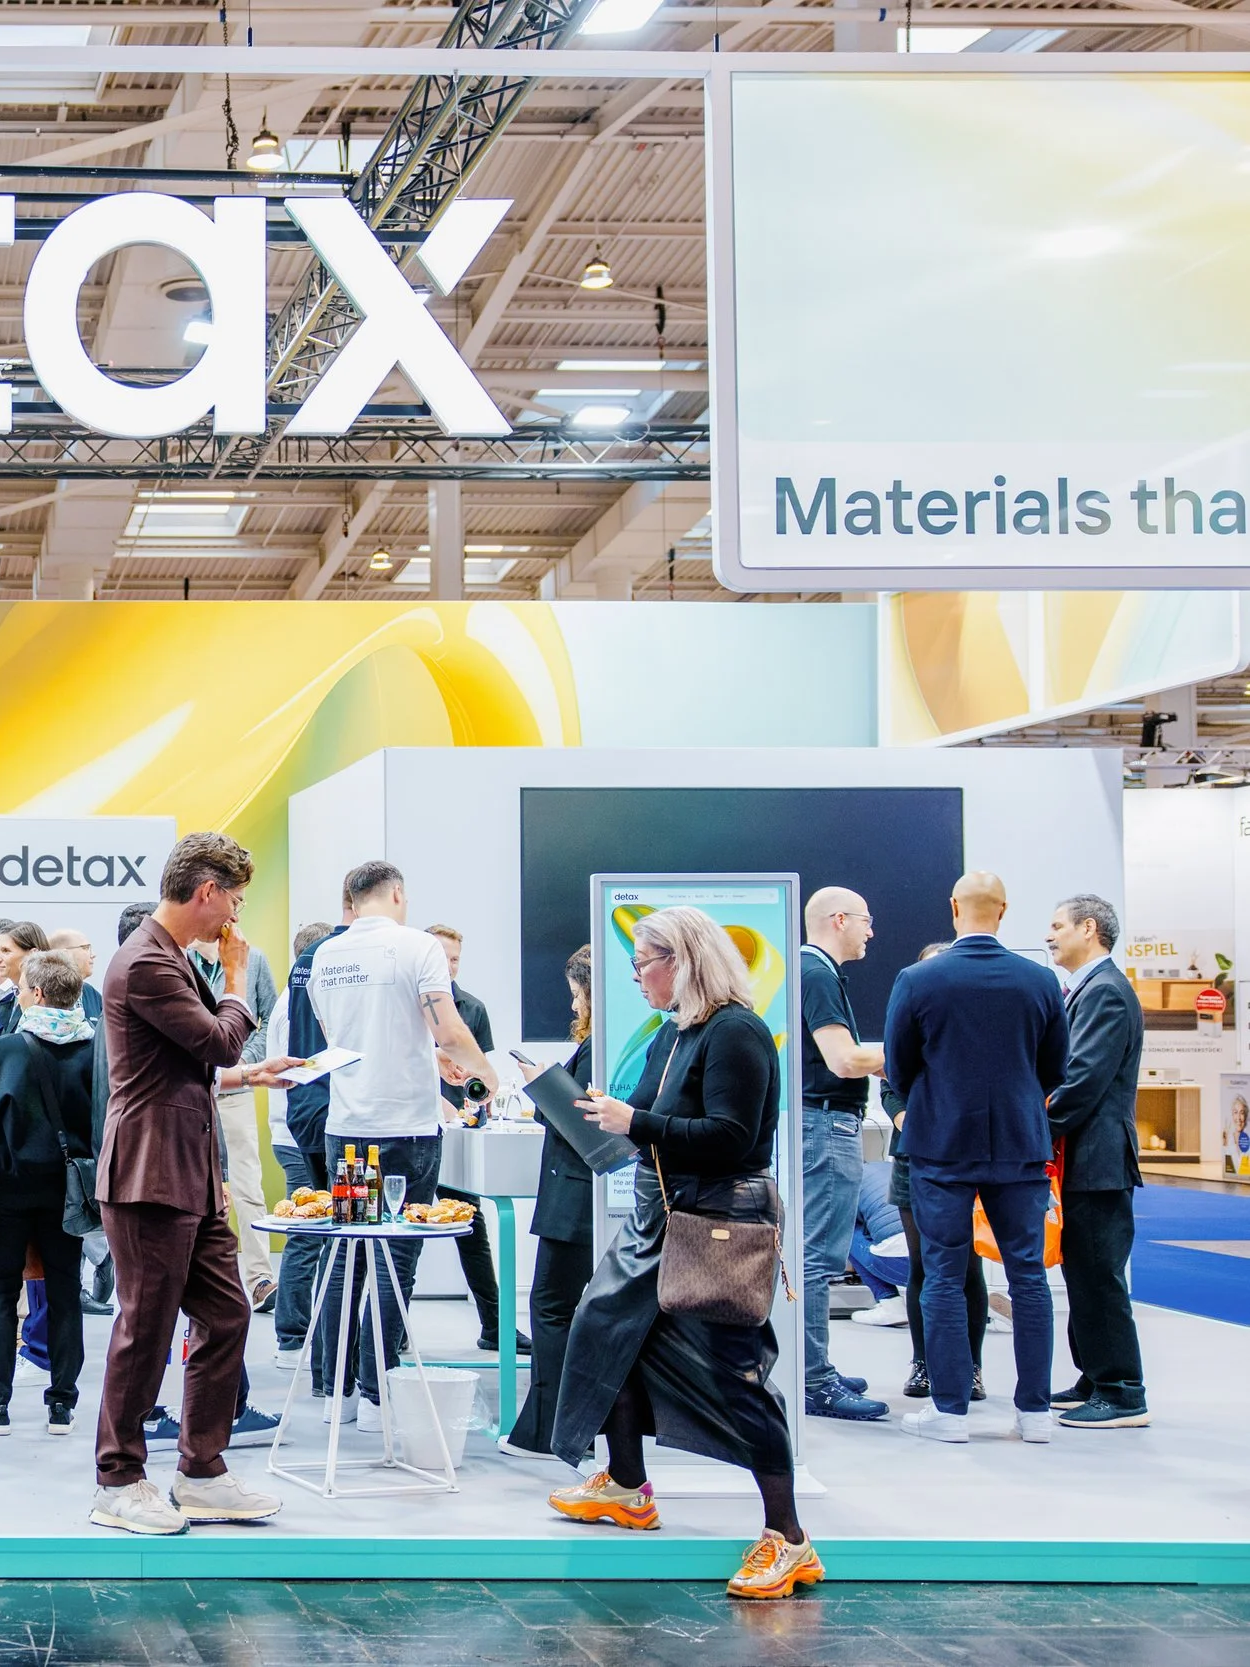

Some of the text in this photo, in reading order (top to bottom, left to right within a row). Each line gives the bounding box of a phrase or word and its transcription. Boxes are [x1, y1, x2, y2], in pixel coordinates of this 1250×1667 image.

[775, 475, 1111, 536] Materials
[614, 893, 639, 901] detax
[321, 963, 361, 976] Materials
[338, 974, 370, 985] matter
